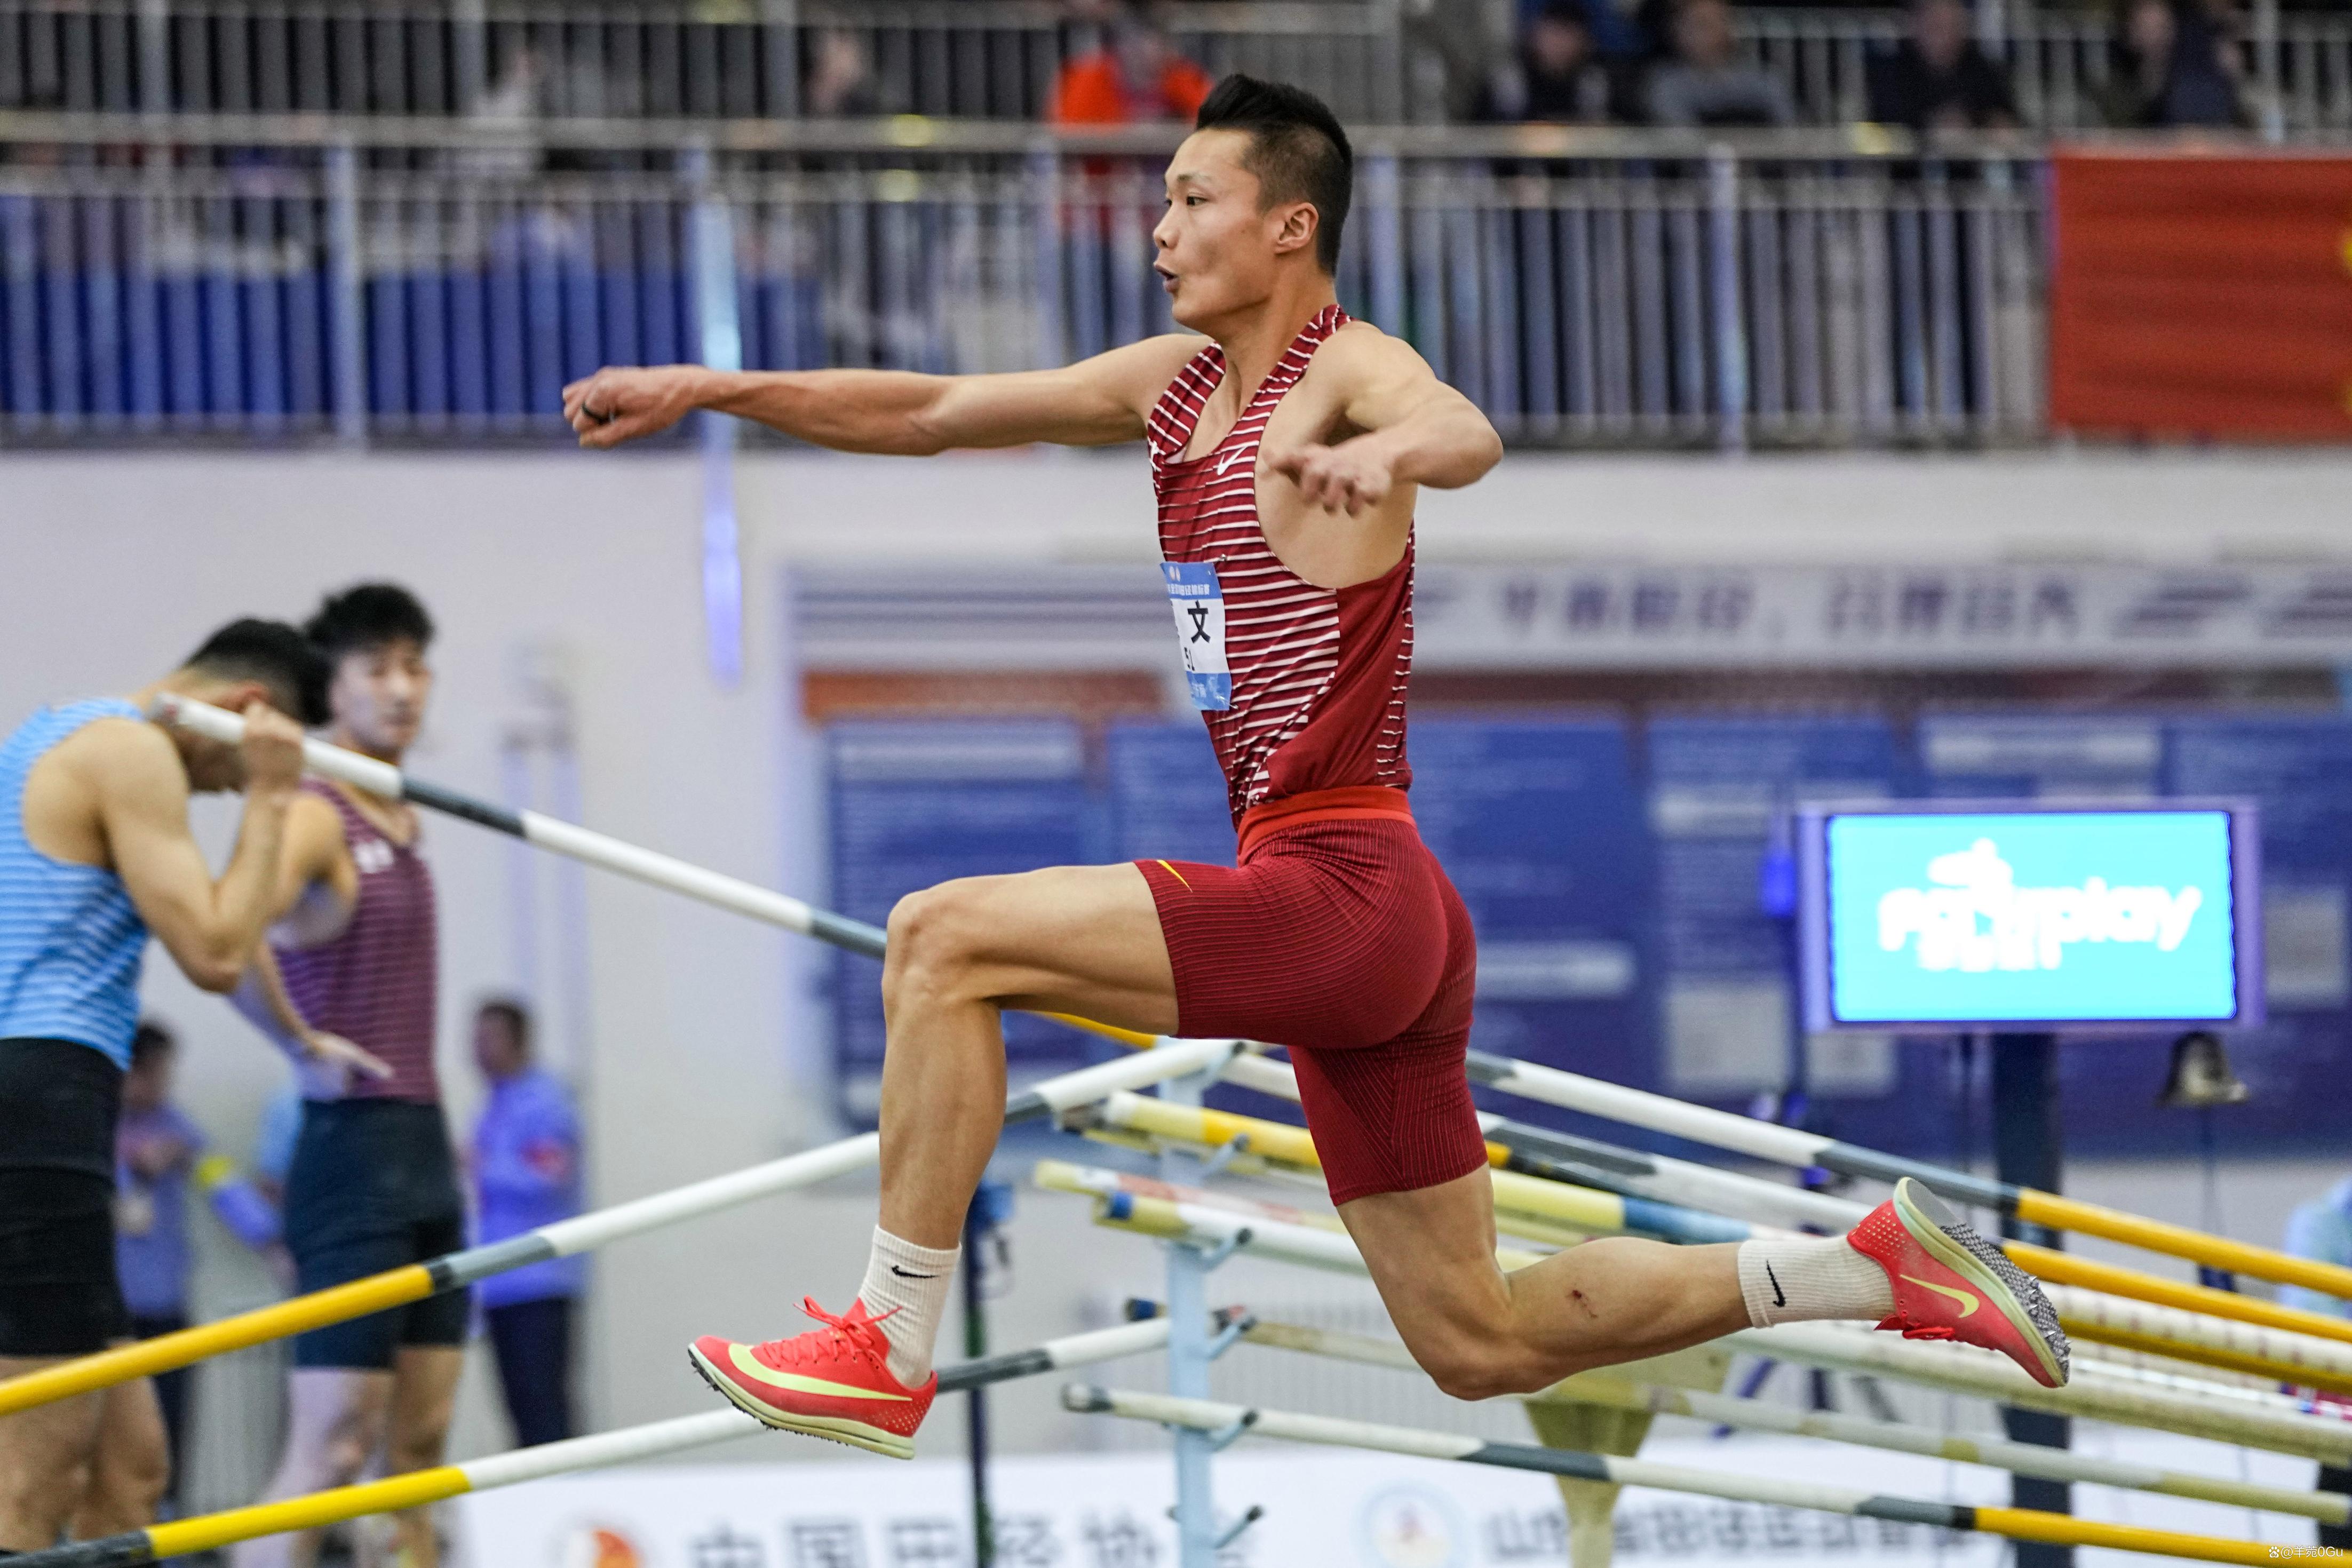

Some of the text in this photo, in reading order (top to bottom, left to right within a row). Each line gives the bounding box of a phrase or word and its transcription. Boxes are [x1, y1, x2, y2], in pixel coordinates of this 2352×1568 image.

[1187, 599, 1211, 643] 文
[690, 1514, 1246, 1567] 中国田径协
